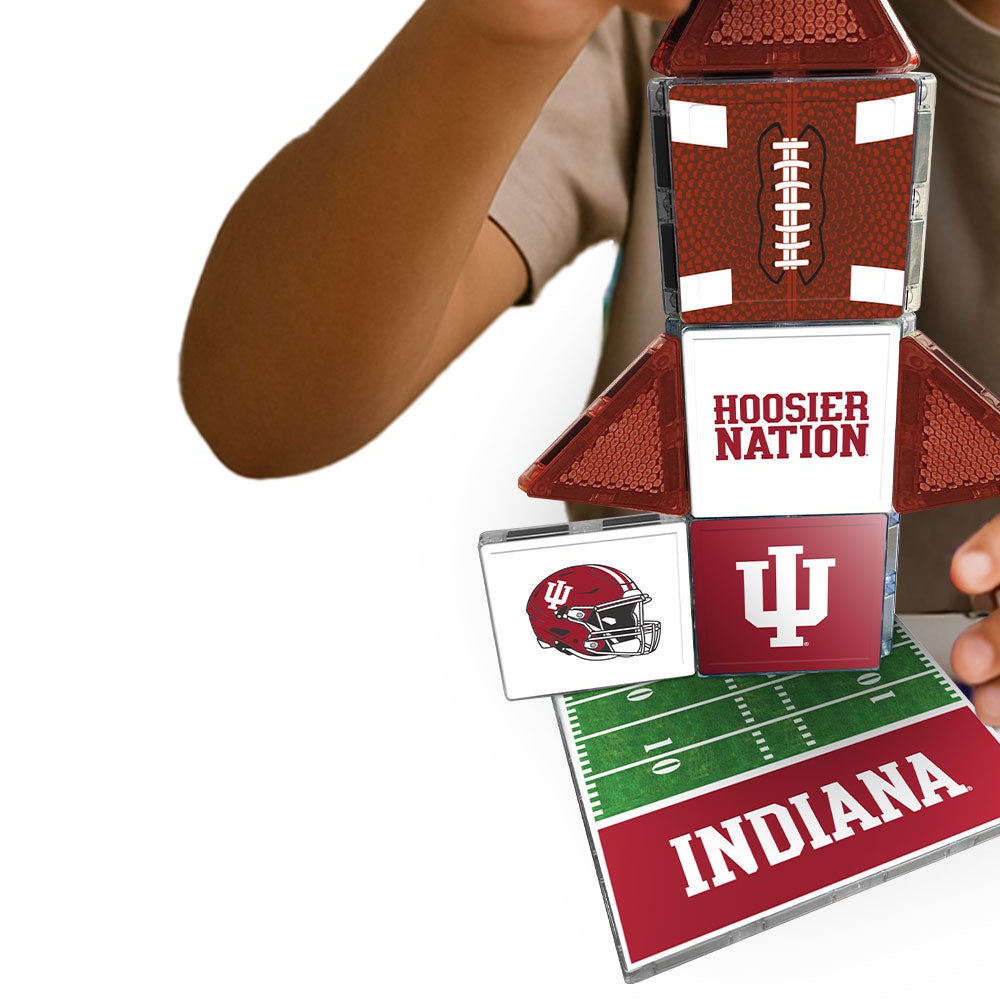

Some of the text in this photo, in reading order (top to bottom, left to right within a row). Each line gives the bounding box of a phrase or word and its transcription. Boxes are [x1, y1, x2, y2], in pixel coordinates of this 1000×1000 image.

[713, 391, 869, 425] HOOSIER
[714, 423, 869, 461] NATION
[668, 751, 970, 898] INDIANA
